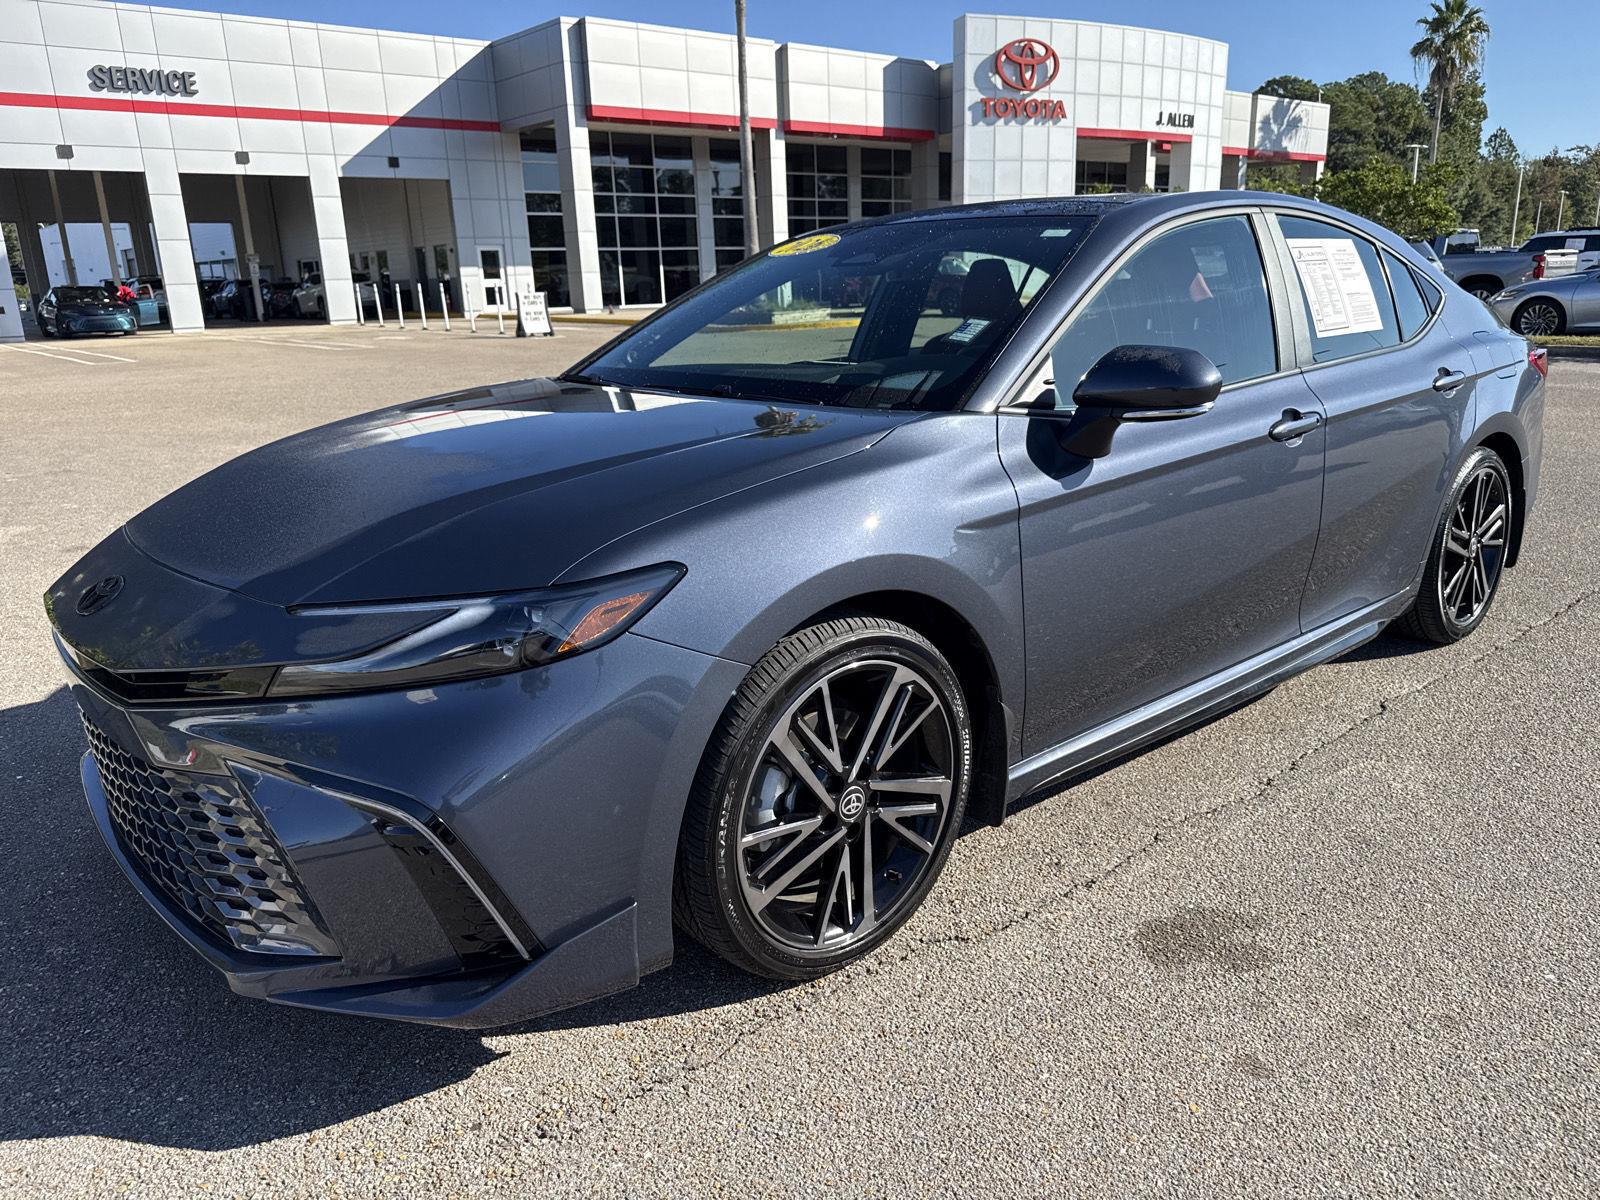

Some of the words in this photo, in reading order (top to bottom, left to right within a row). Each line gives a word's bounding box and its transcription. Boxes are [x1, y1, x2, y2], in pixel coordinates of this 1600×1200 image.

[91, 65, 199, 96] SERVICE
[981, 98, 1067, 119] TOYOTA
[1155, 111, 1165, 126] J.
[1166, 112, 1195, 128] ALLEN
